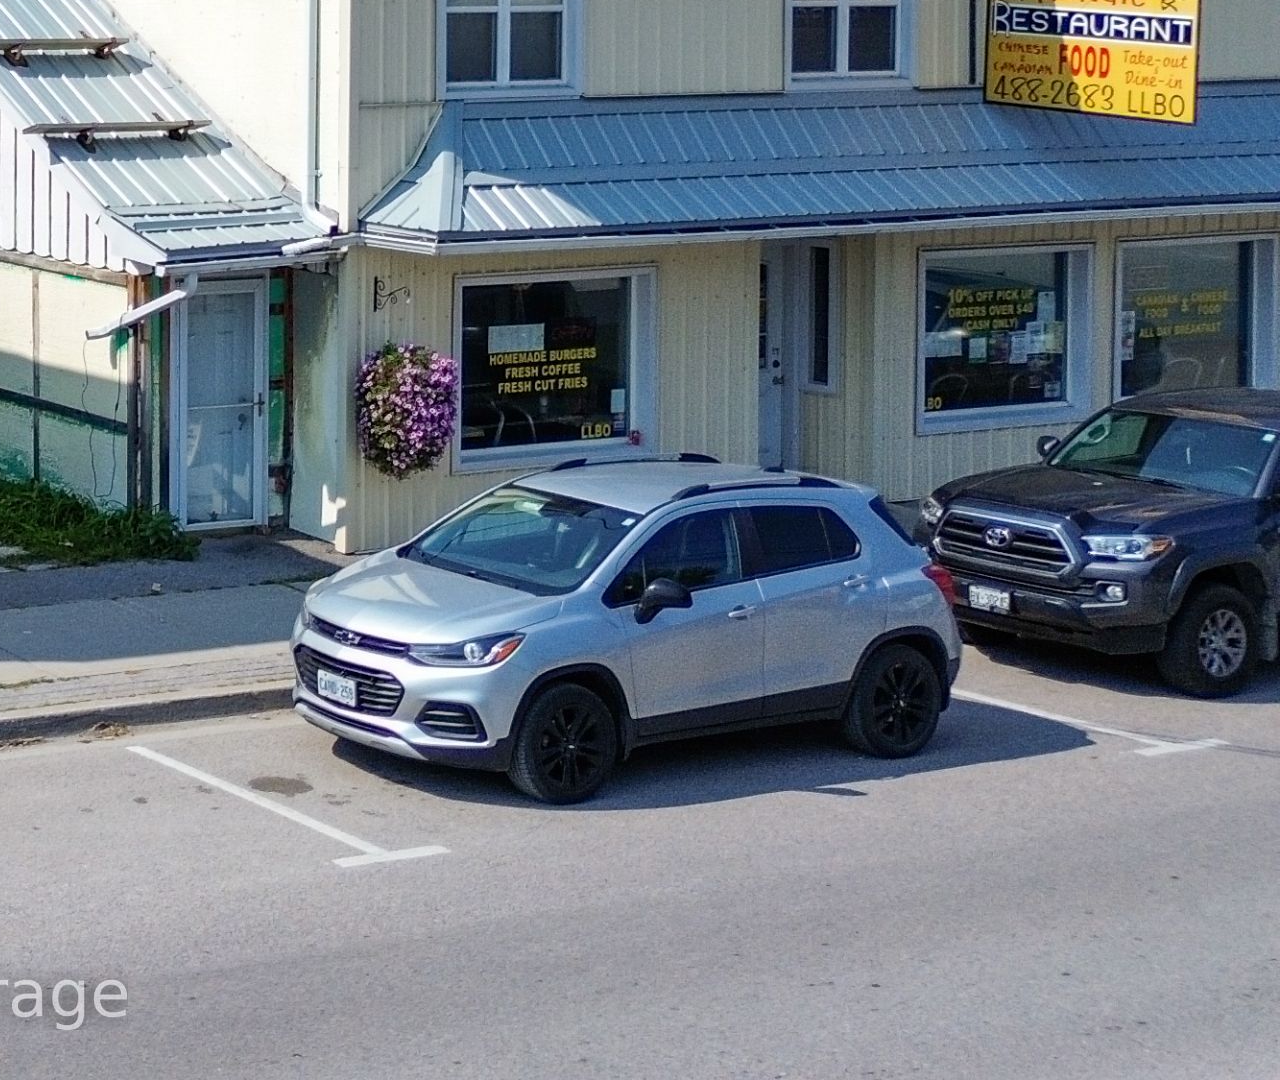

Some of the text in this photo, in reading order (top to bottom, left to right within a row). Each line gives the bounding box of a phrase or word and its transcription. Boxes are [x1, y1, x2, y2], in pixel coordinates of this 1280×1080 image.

[998, 41, 1049, 55] CHINESE
[993, 61, 1053, 75] CANADIAN
[1058, 43, 1111, 78] FOOD
[1123, 50, 1188, 69] Take-out
[1125, 70, 1183, 89] Dine-in
[993, 74, 1186, 118] 488-2683 LLBO
[976, 291, 995, 302] OFF
[948, 305, 987, 318] ORDERS
[988, 304, 1015, 316] OVER
[489, 347, 597, 366] HOMEMADE BURGERS
[505, 363, 581, 379] FRESH COFFEE
[498, 376, 588, 394] FRESH CUT FRIES
[581, 423, 612, 439] LLBO
